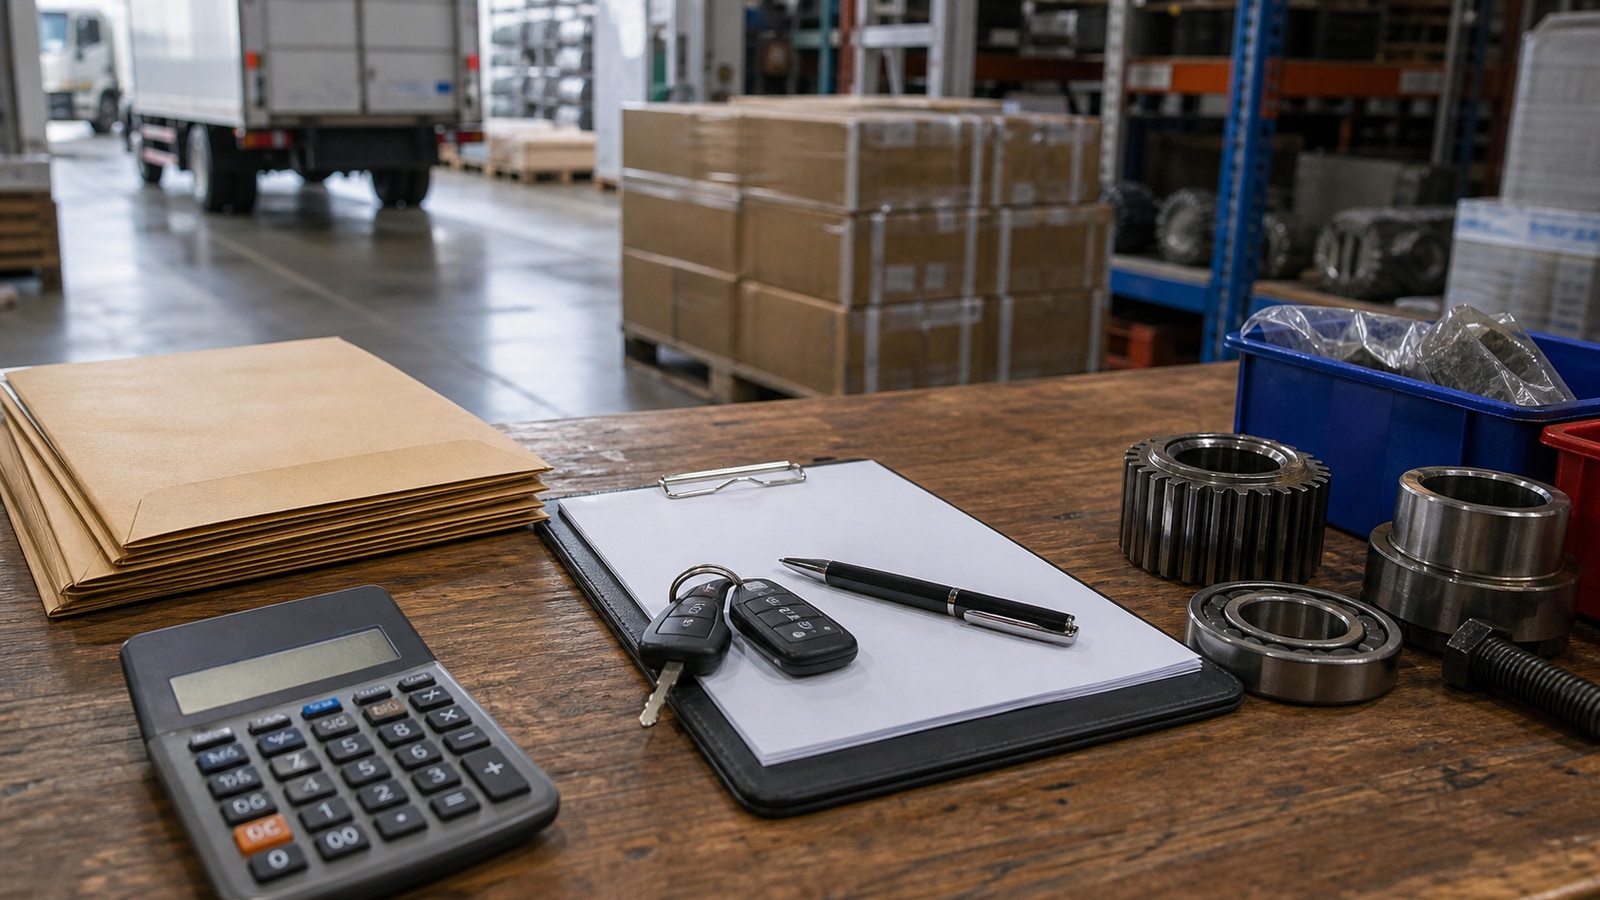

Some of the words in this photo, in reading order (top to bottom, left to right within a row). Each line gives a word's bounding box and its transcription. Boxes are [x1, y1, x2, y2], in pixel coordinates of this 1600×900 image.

[393, 723, 410, 736] 8
[341, 738, 358, 753] 5
[411, 744, 427, 759] 6
[358, 760, 376, 776] 5
[428, 767, 446, 783] 3
[373, 784, 394, 802] 2
[318, 802, 334, 818] 1
